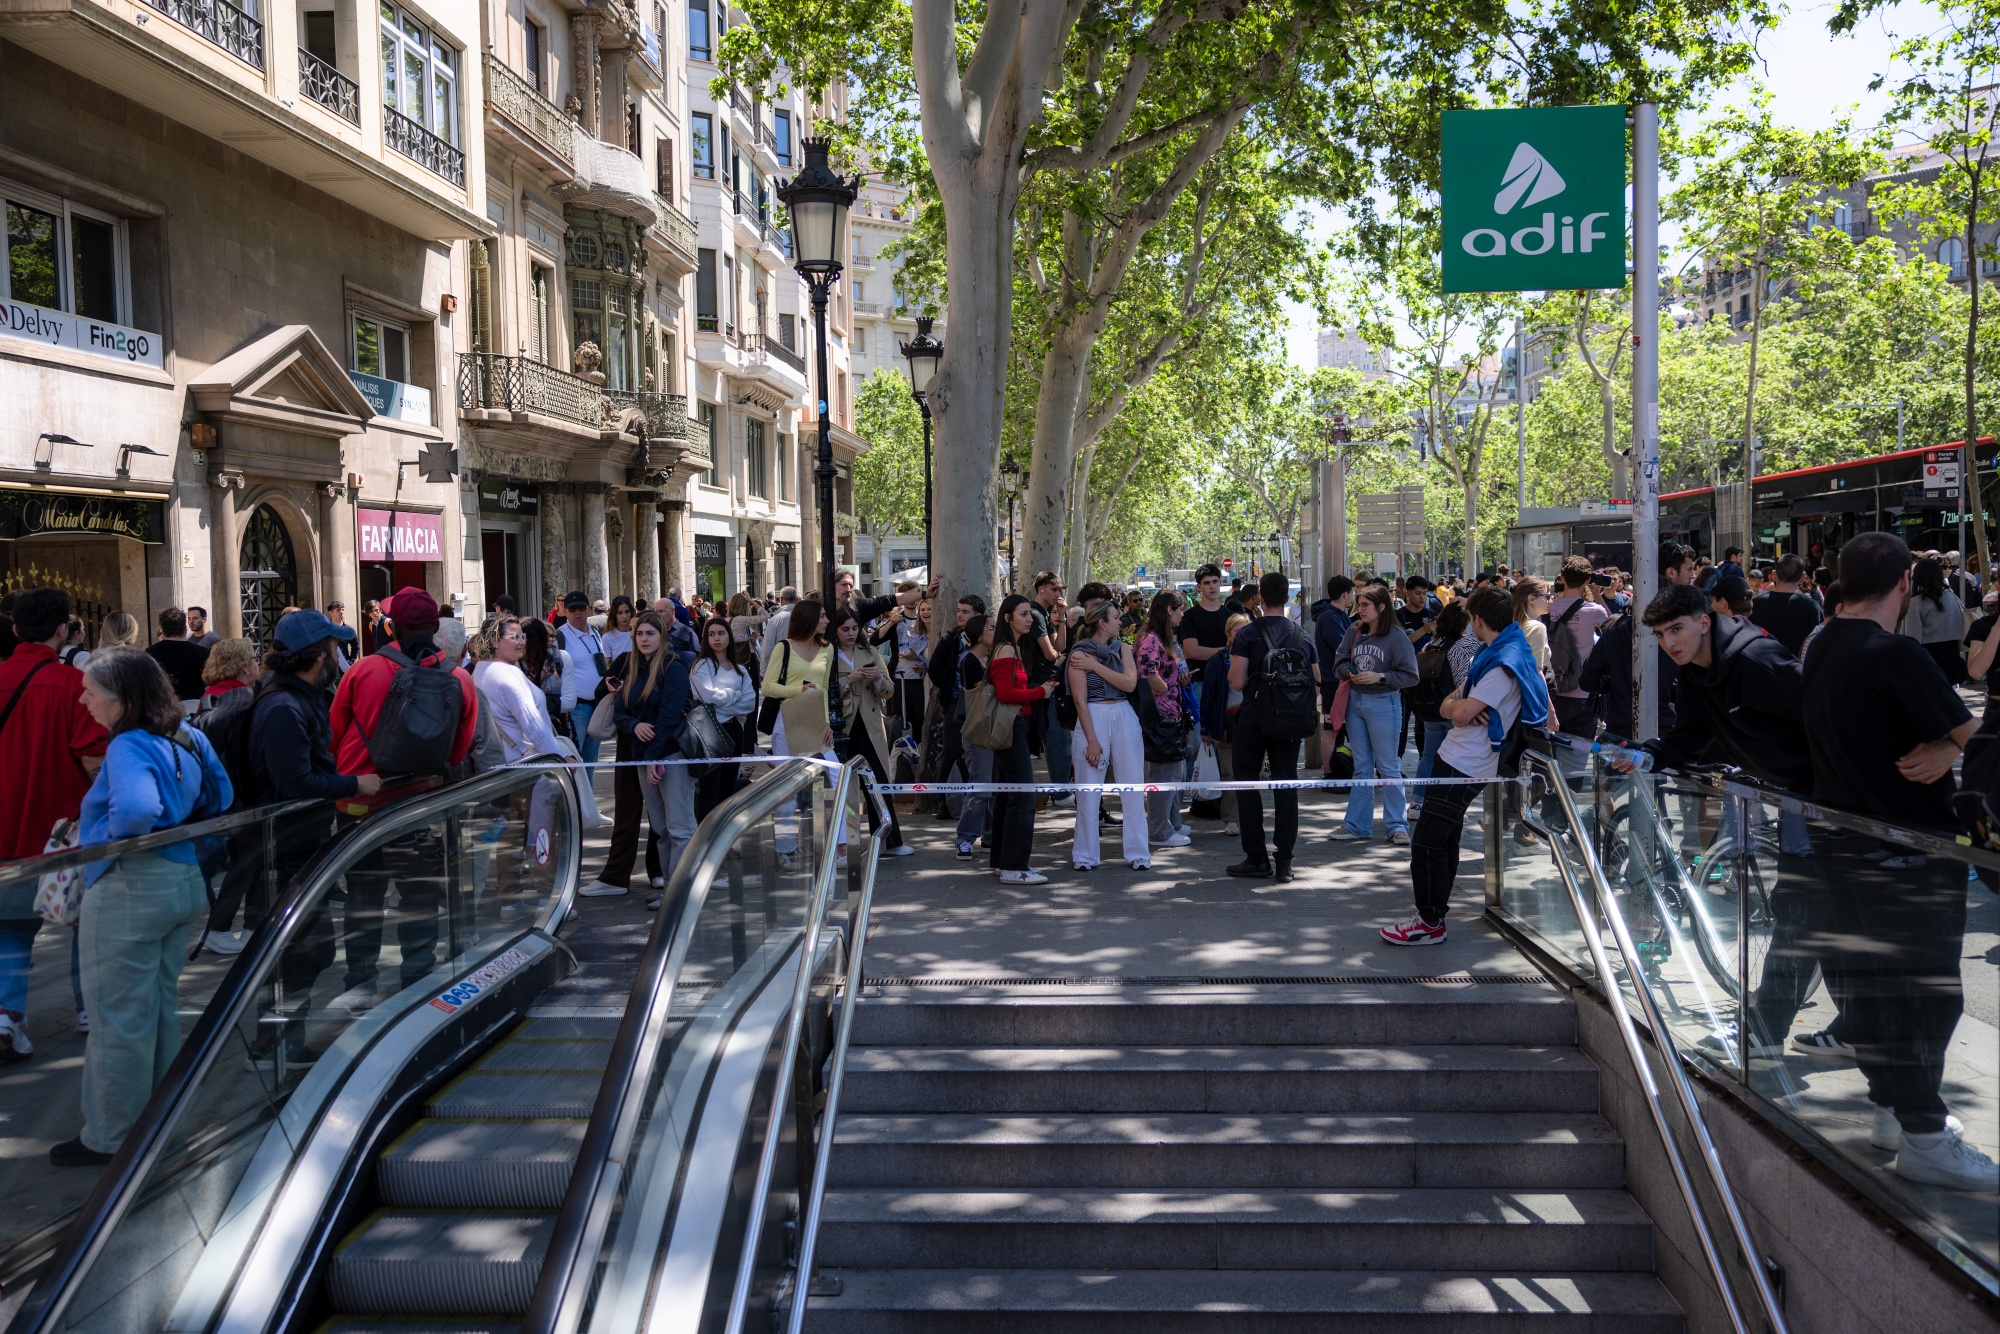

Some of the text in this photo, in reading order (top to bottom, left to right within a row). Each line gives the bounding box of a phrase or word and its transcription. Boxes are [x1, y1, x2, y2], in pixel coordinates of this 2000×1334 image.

[1461, 211, 1610, 257] adif
[9, 304, 63, 345] Delvy
[1928, 453, 1935, 461] B
[1940, 510, 1947, 527] 7
[361, 521, 439, 554] FARMÀCIA
